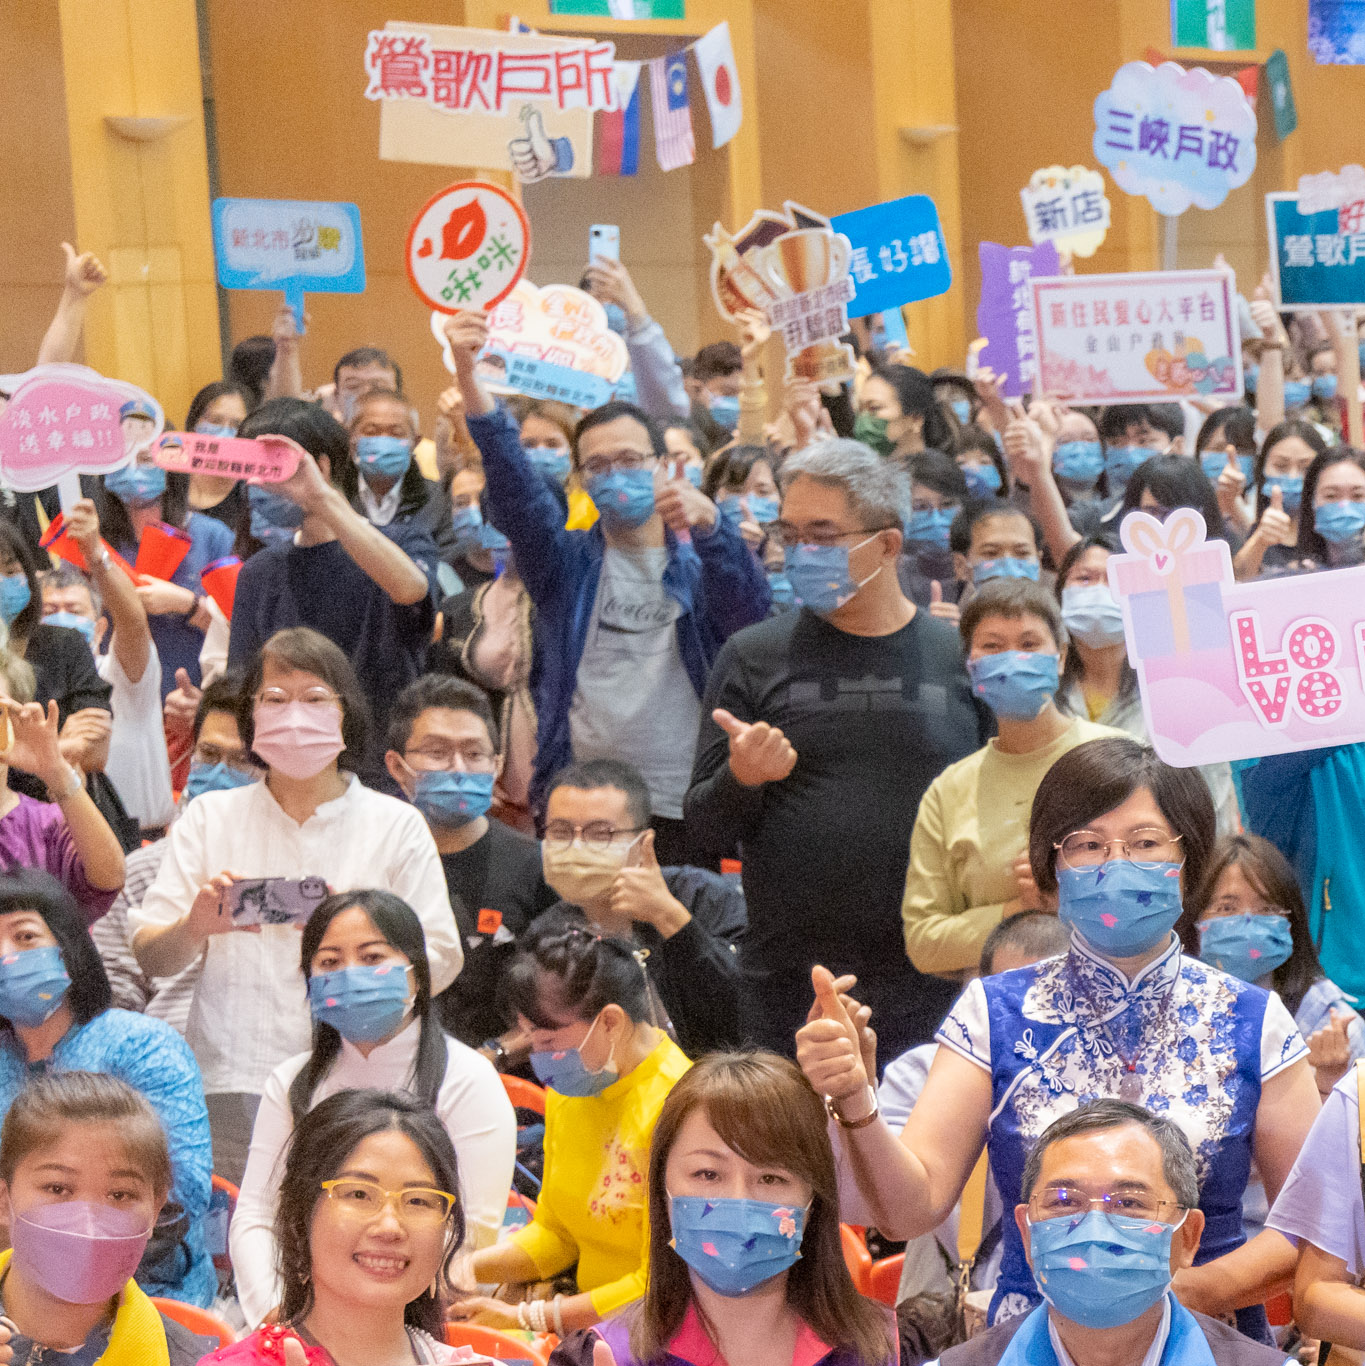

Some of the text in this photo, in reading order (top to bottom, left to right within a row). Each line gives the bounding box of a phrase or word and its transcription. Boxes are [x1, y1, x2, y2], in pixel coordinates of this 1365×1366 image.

[371, 36, 613, 111] 鶯歌戶所
[1105, 109, 1239, 173] 三峽戶政
[1033, 189, 1103, 233] 新店
